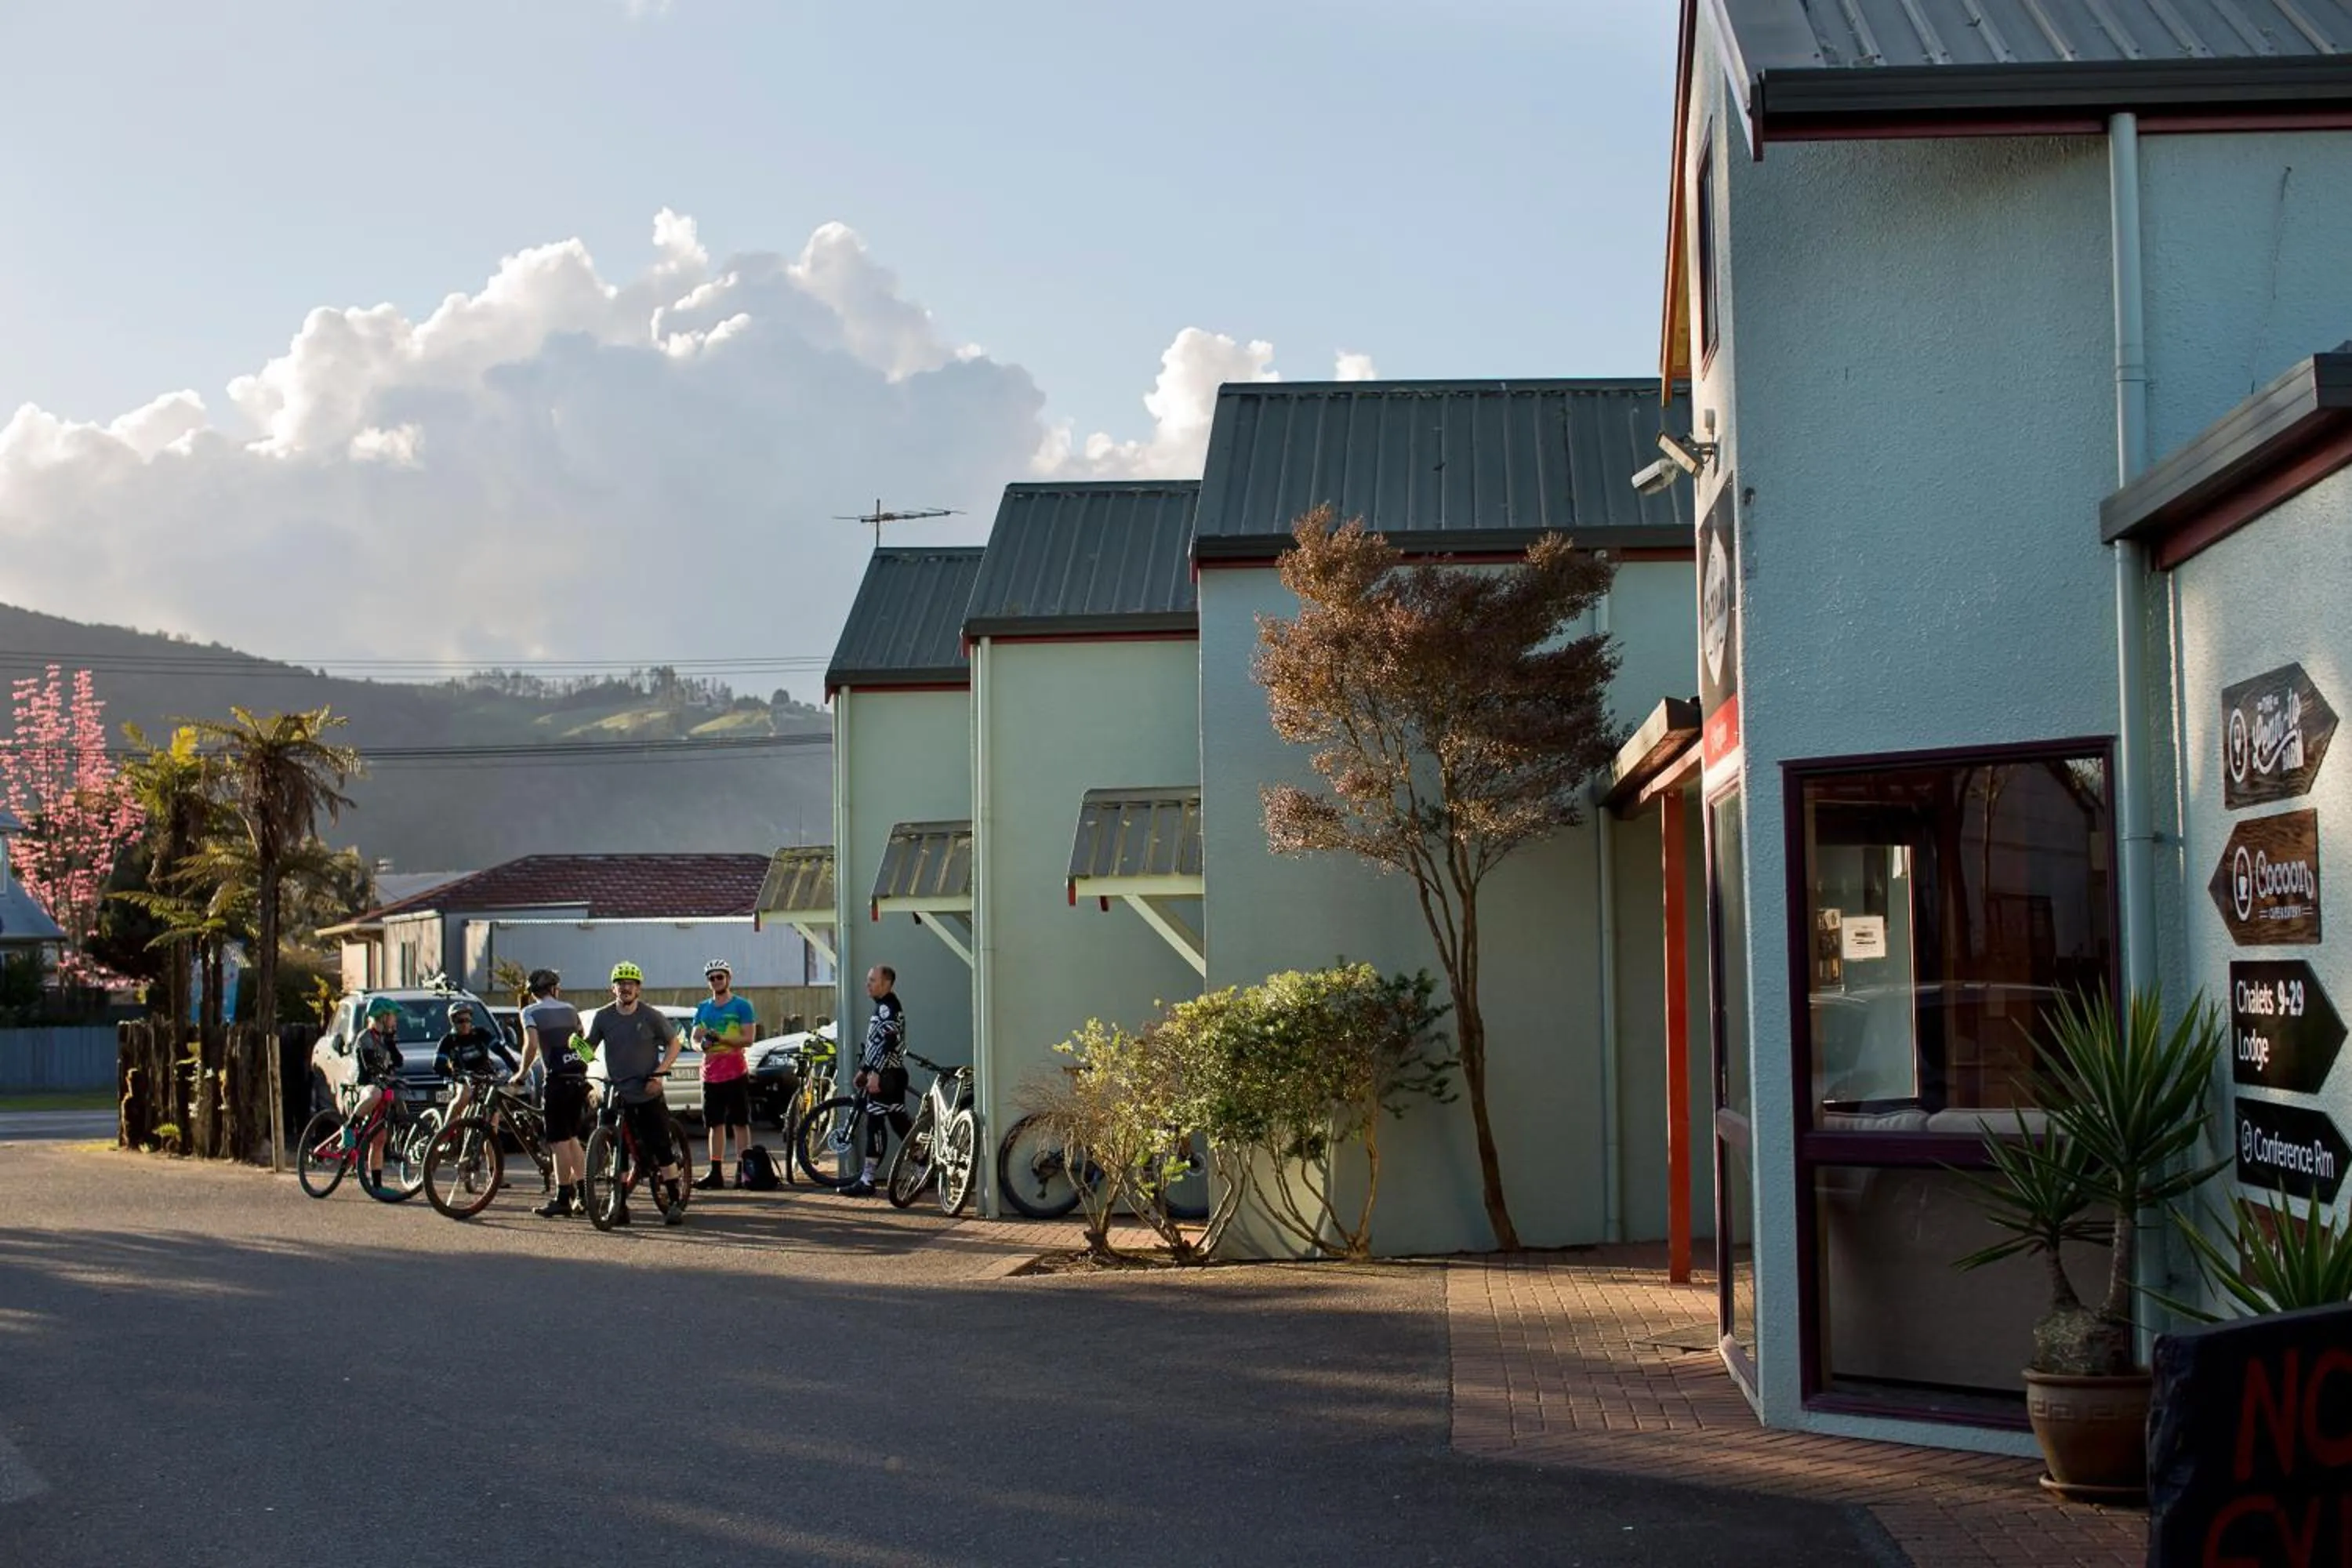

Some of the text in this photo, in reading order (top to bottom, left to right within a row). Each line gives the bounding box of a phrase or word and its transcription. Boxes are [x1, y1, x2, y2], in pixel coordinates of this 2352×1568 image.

[2256, 850, 2314, 899] Cocoon
[2236, 979, 2304, 1017] Chalets 9-29
[2238, 1028, 2270, 1071] Lodge
[2254, 1127, 2334, 1179] Conference Rm
